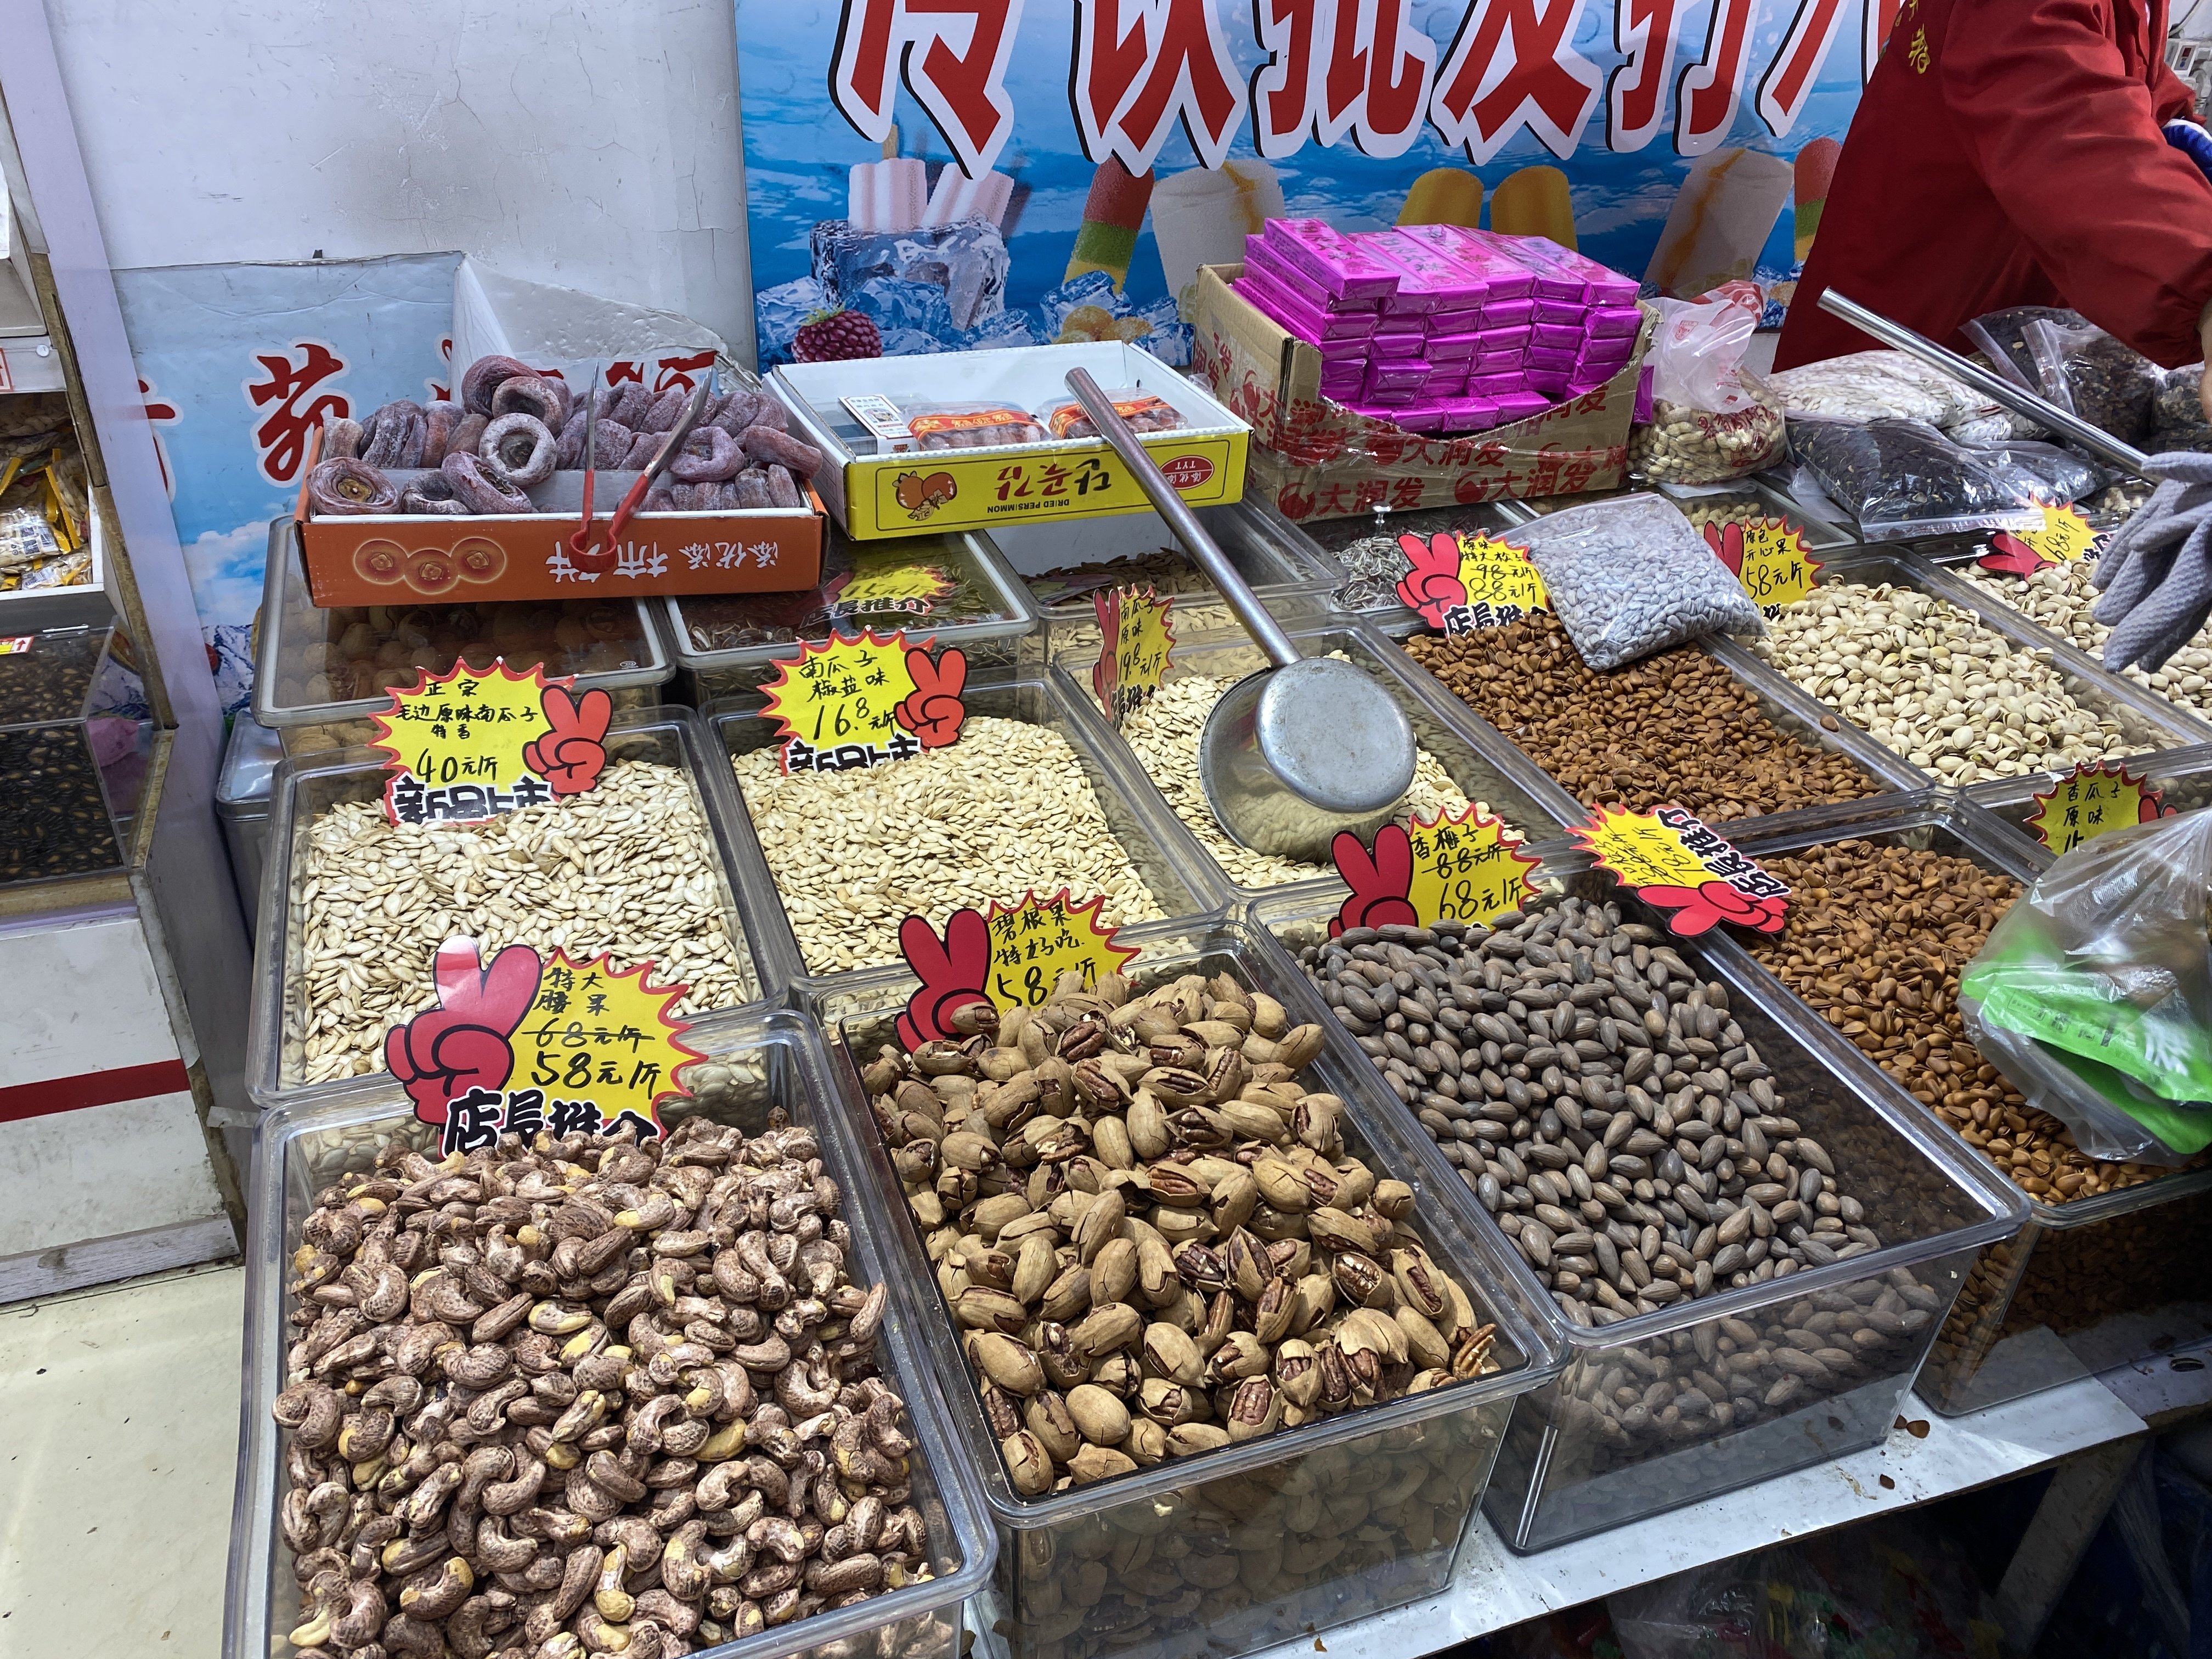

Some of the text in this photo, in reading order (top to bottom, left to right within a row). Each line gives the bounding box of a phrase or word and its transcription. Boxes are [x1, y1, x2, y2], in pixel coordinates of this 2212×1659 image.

[1175, 460, 1196, 470] TYT
[987, 499, 1070, 514] DRIED PERSIMMON
[679, 540, 778, 570] 添优添
[1745, 538, 1791, 562] 开心果
[1120, 596, 1154, 623] 南瓜子
[1120, 617, 1143, 646] 原味
[799, 649, 878, 679] 南瓜子
[424, 679, 480, 697] 正宗
[806, 667, 890, 703] 椒盐味
[394, 703, 538, 723] 毛边原味南瓜子
[430, 723, 471, 740] 特香
[2067, 780, 2121, 803] 香瓜子
[2063, 805, 2104, 827] 原味
[990, 900, 1072, 944] 碧根果
[542, 967, 605, 989] 特大
[532, 990, 610, 1016] 腰果
